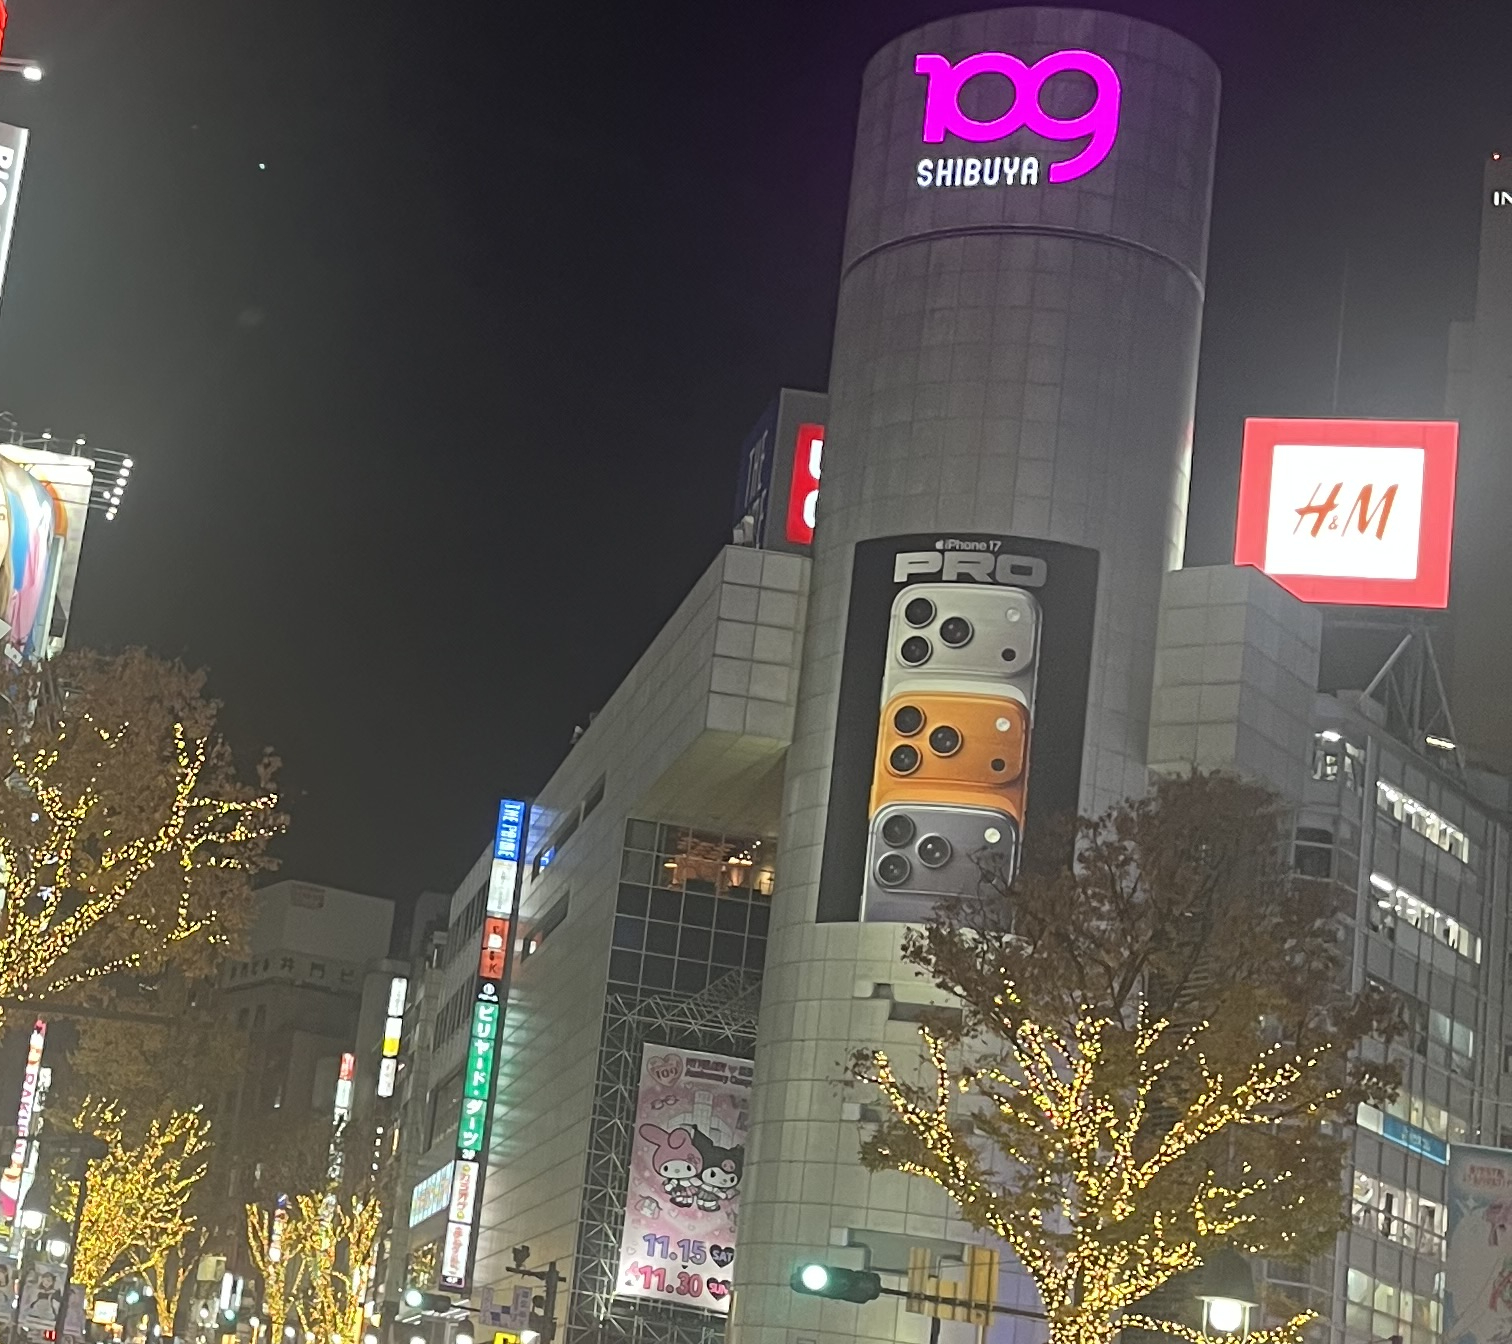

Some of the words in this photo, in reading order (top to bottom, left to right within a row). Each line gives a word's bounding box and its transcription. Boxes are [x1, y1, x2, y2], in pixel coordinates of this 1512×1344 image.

[915, 50, 1122, 184] 109
[916, 156, 1040, 187] SHIBUYA
[1293, 481, 1399, 543] H&M
[944, 538, 987, 551] iPhone
[989, 540, 1002, 552] 17
[893, 551, 1048, 588] PRO
[642, 1232, 707, 1266] 11.15
[711, 1248, 735, 1264] SAT
[639, 1264, 704, 1298] 11.30
